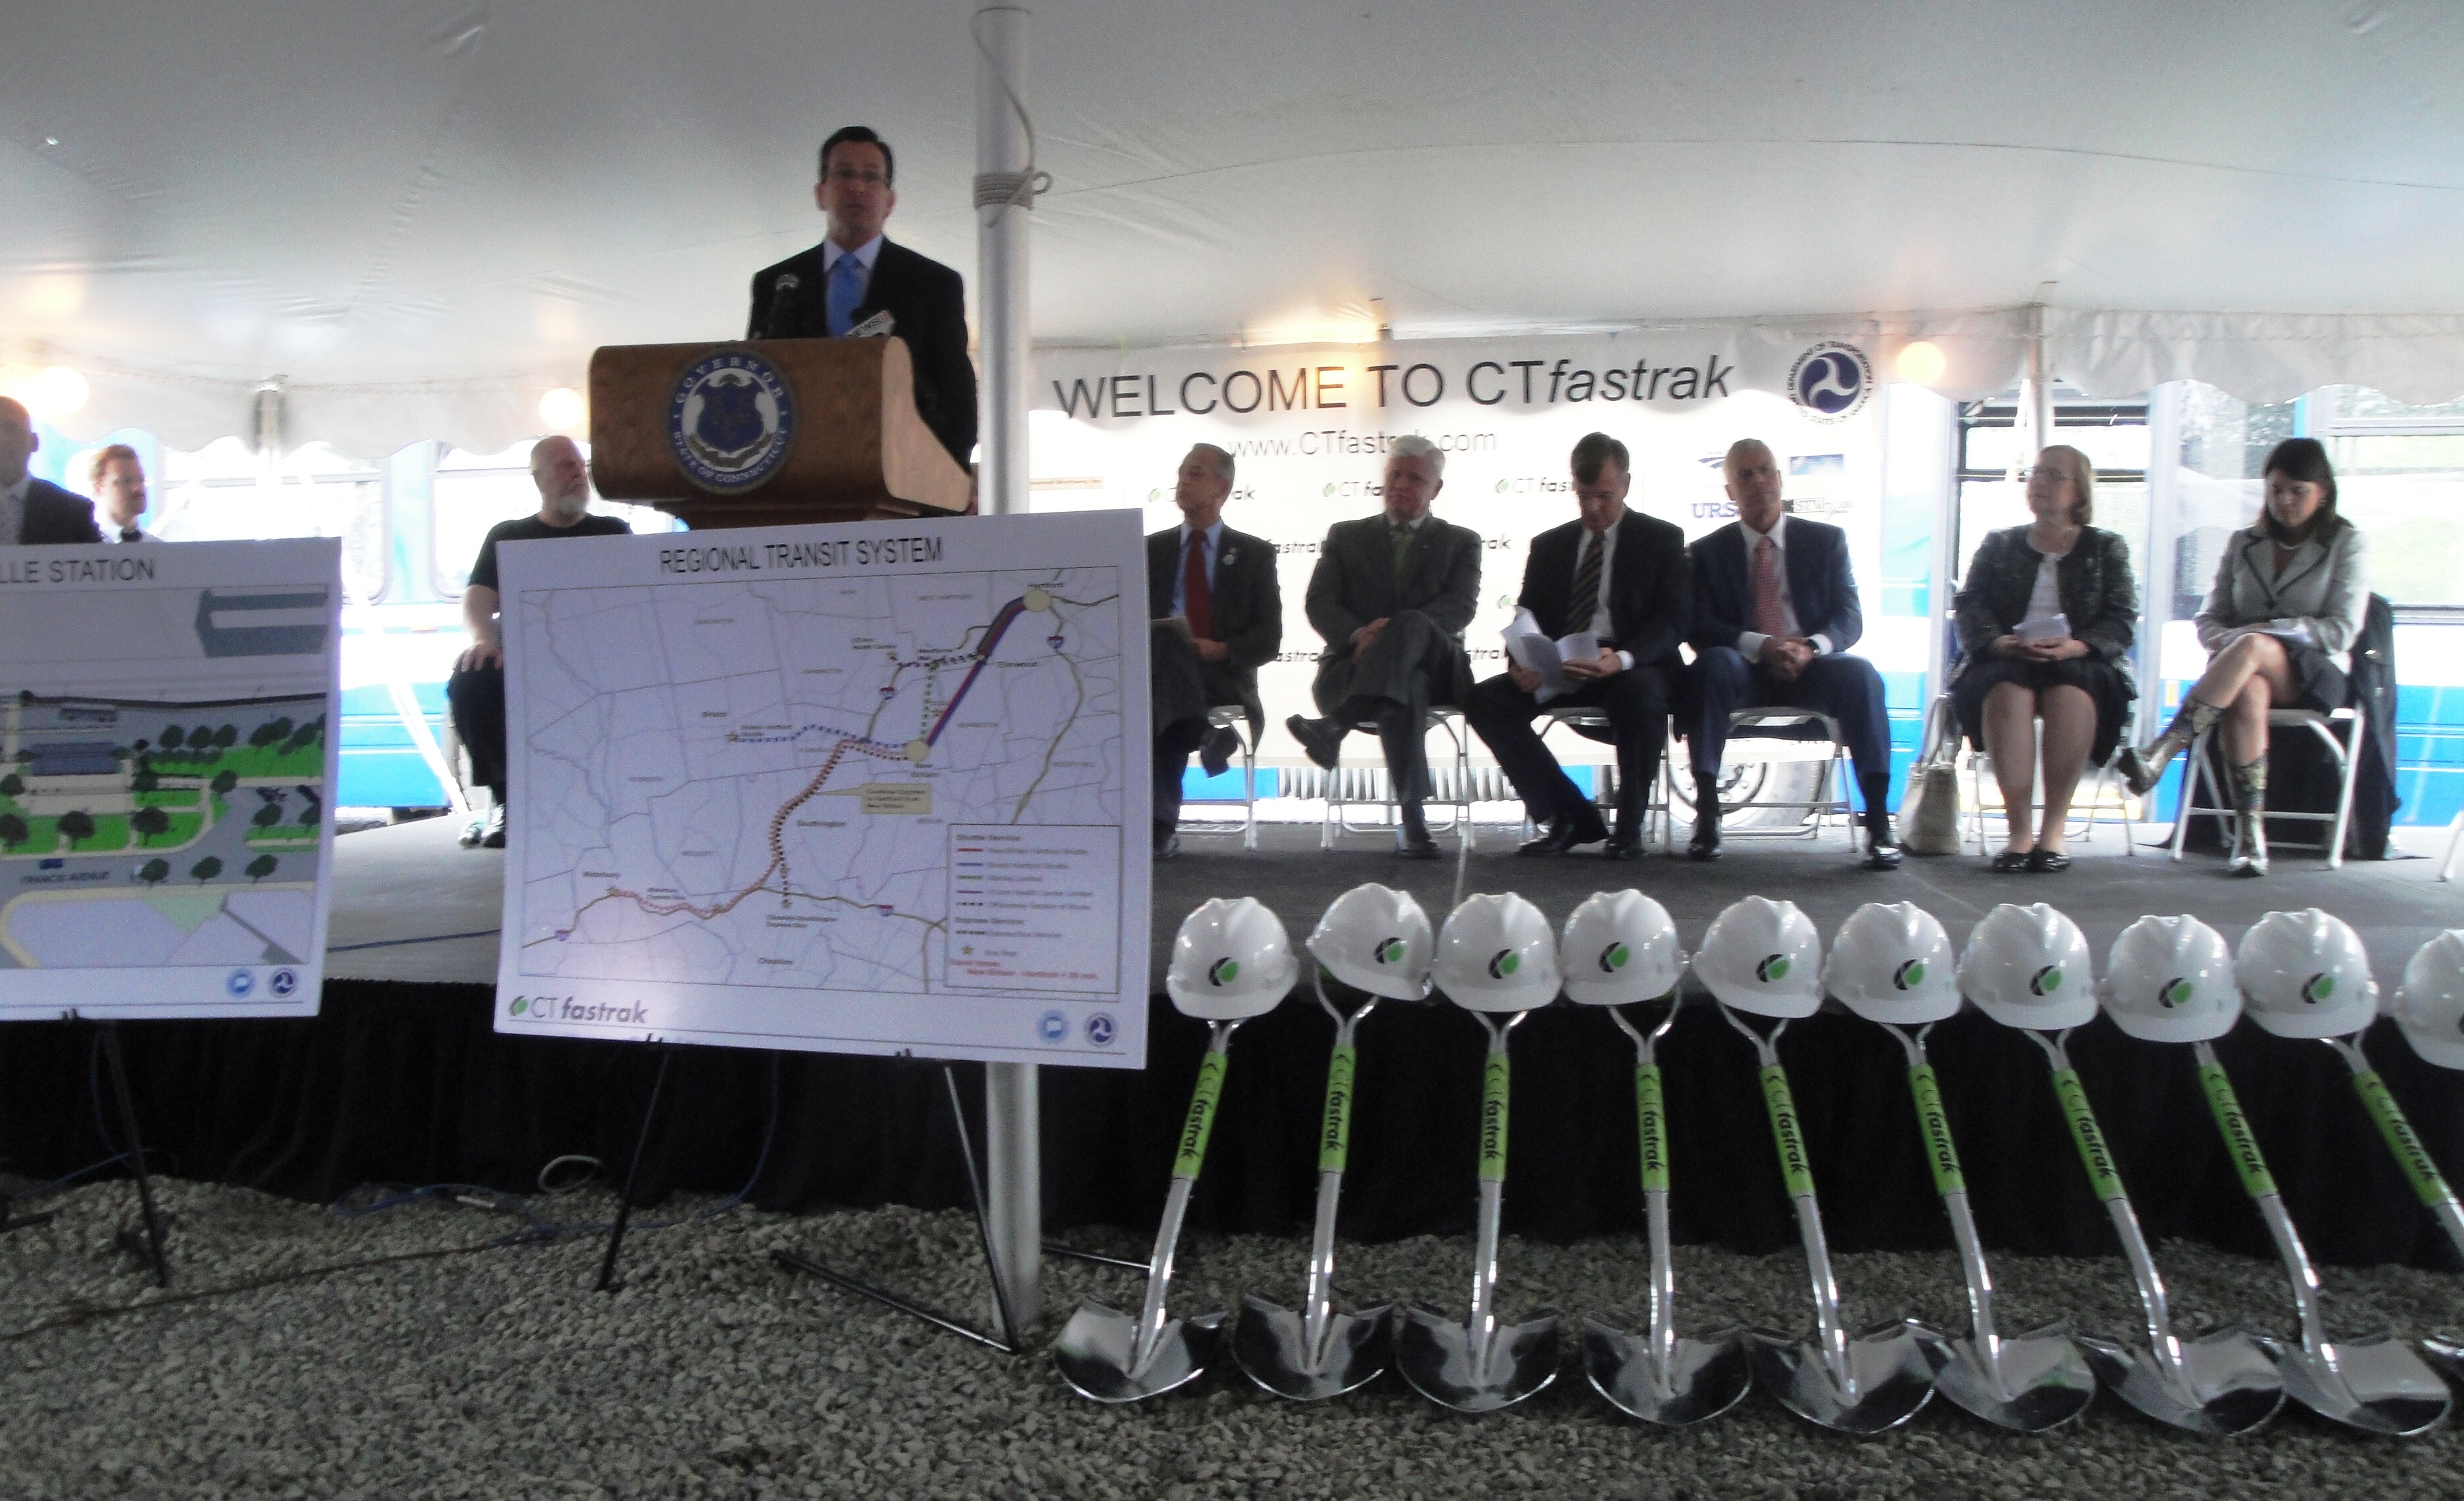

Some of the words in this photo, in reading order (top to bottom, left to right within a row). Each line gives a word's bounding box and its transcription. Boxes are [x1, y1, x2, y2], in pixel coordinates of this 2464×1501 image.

[1052, 366, 1348, 419] WELCOME
[1367, 363, 1445, 408] TO
[1465, 354, 1736, 405] CTfastrak
[1228, 429, 1497, 458] www.CTfastr.com
[48, 558, 155, 583] STATION
[659, 546, 760, 575] REGIONAL
[764, 540, 849, 569] TRANSIT
[855, 536, 944, 566] SYSTEM
